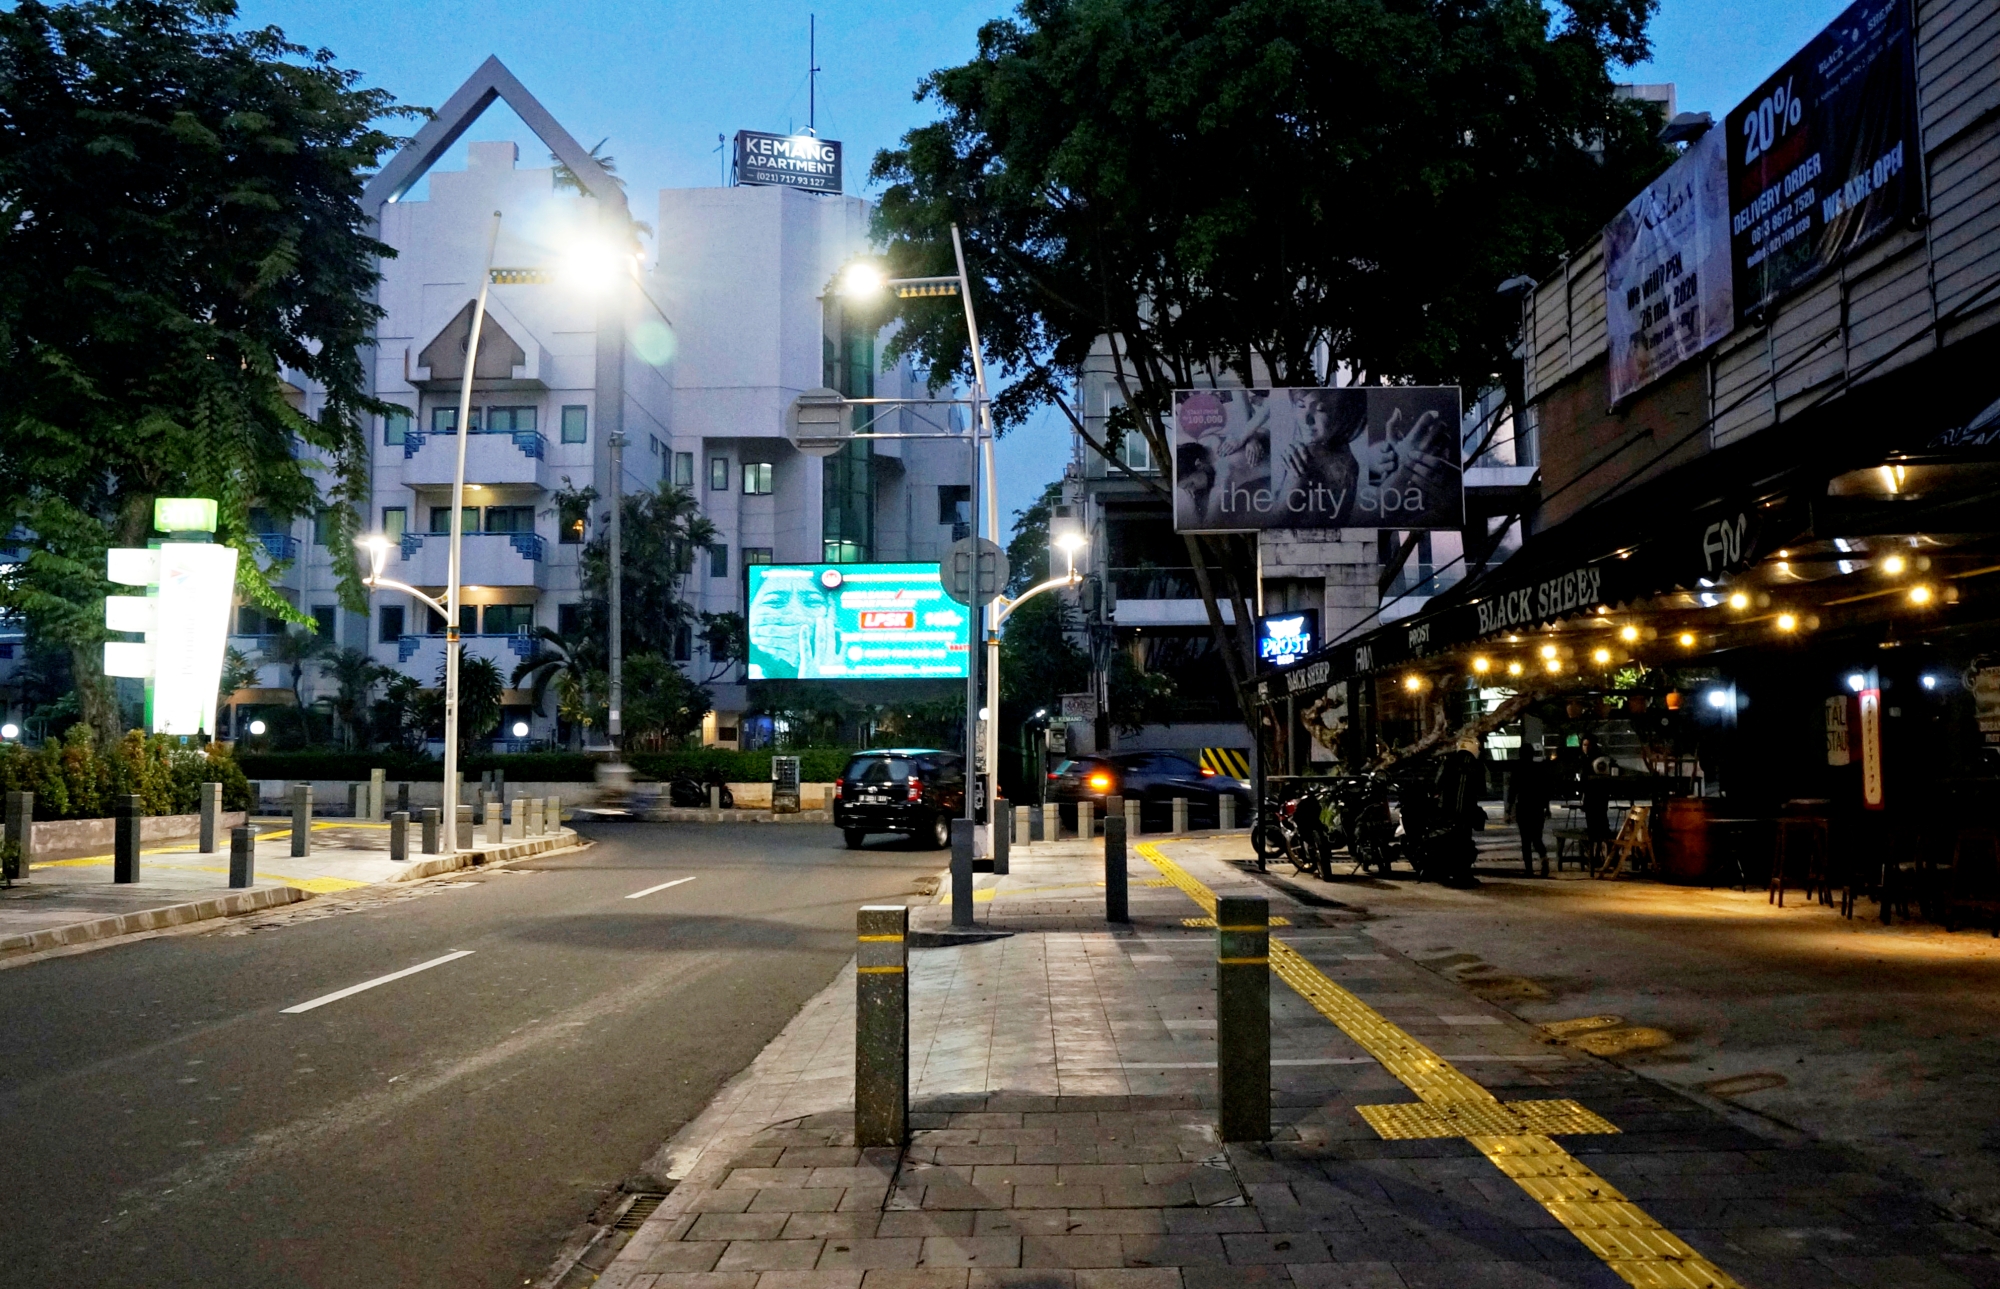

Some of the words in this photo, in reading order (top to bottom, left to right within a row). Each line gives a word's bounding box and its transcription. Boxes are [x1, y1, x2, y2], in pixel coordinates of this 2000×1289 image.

[1743, 74, 1801, 166] 20%
[746, 138, 835, 161] KEMANG
[746, 155, 835, 174] APARTMENT
[756, 172, 779, 182] (021)
[780, 175, 796, 184] 717
[797, 176, 809, 185] 93
[810, 178, 826, 187] 127
[1733, 181, 1782, 236] DELIVERY
[1784, 151, 1823, 198] ORDER
[1844, 168, 1872, 210] ARE
[1627, 286, 1640, 311] We
[1641, 269, 1659, 300] will
[1640, 305, 1652, 331] 26
[1673, 272, 1697, 309] 2020
[1220, 482, 1274, 513] the
[1286, 482, 1347, 519] city
[1359, 487, 1426, 519] spa
[1477, 586, 1533, 635] BLACK
[1537, 566, 1601, 619] SHEEP
[864, 613, 908, 627] LPSK
[1409, 623, 1430, 649] PROST
[1261, 633, 1310, 658] PROST
[1307, 661, 1330, 688] SHEEP
